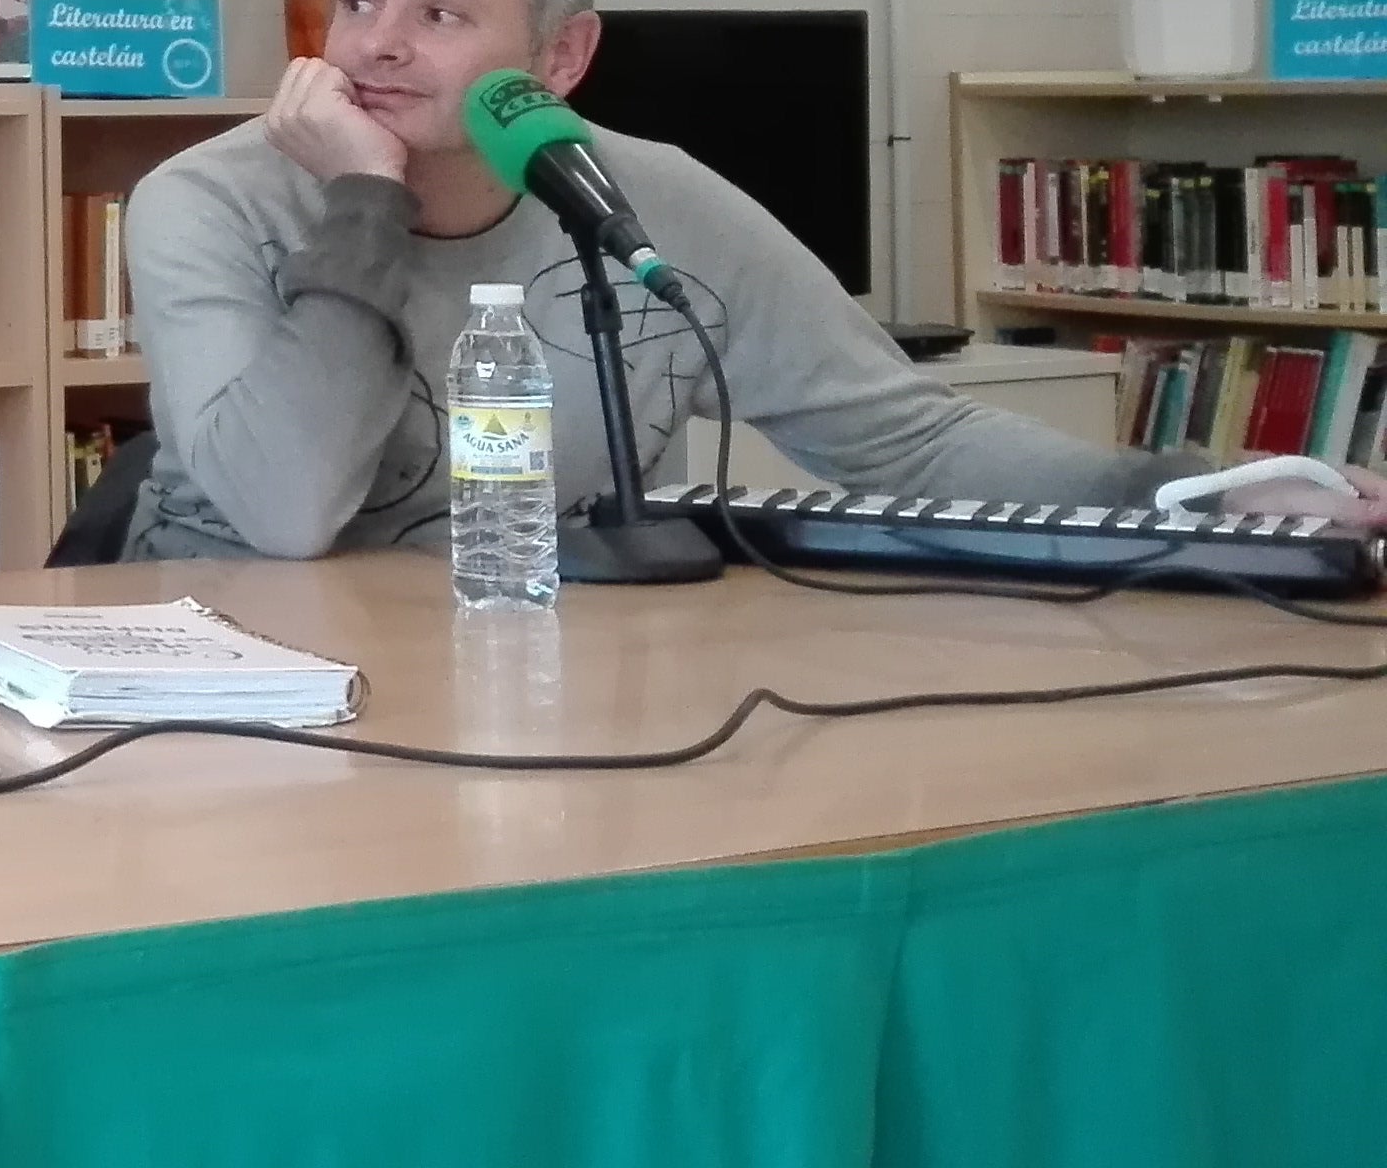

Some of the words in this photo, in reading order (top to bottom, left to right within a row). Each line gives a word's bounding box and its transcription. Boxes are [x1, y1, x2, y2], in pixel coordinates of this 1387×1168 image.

[49, 2, 164, 29] Literatura
[170, 14, 195, 30] en
[51, 43, 146, 68] castelán
[463, 433, 494, 453] AGUA
[497, 433, 530, 453] SANA
